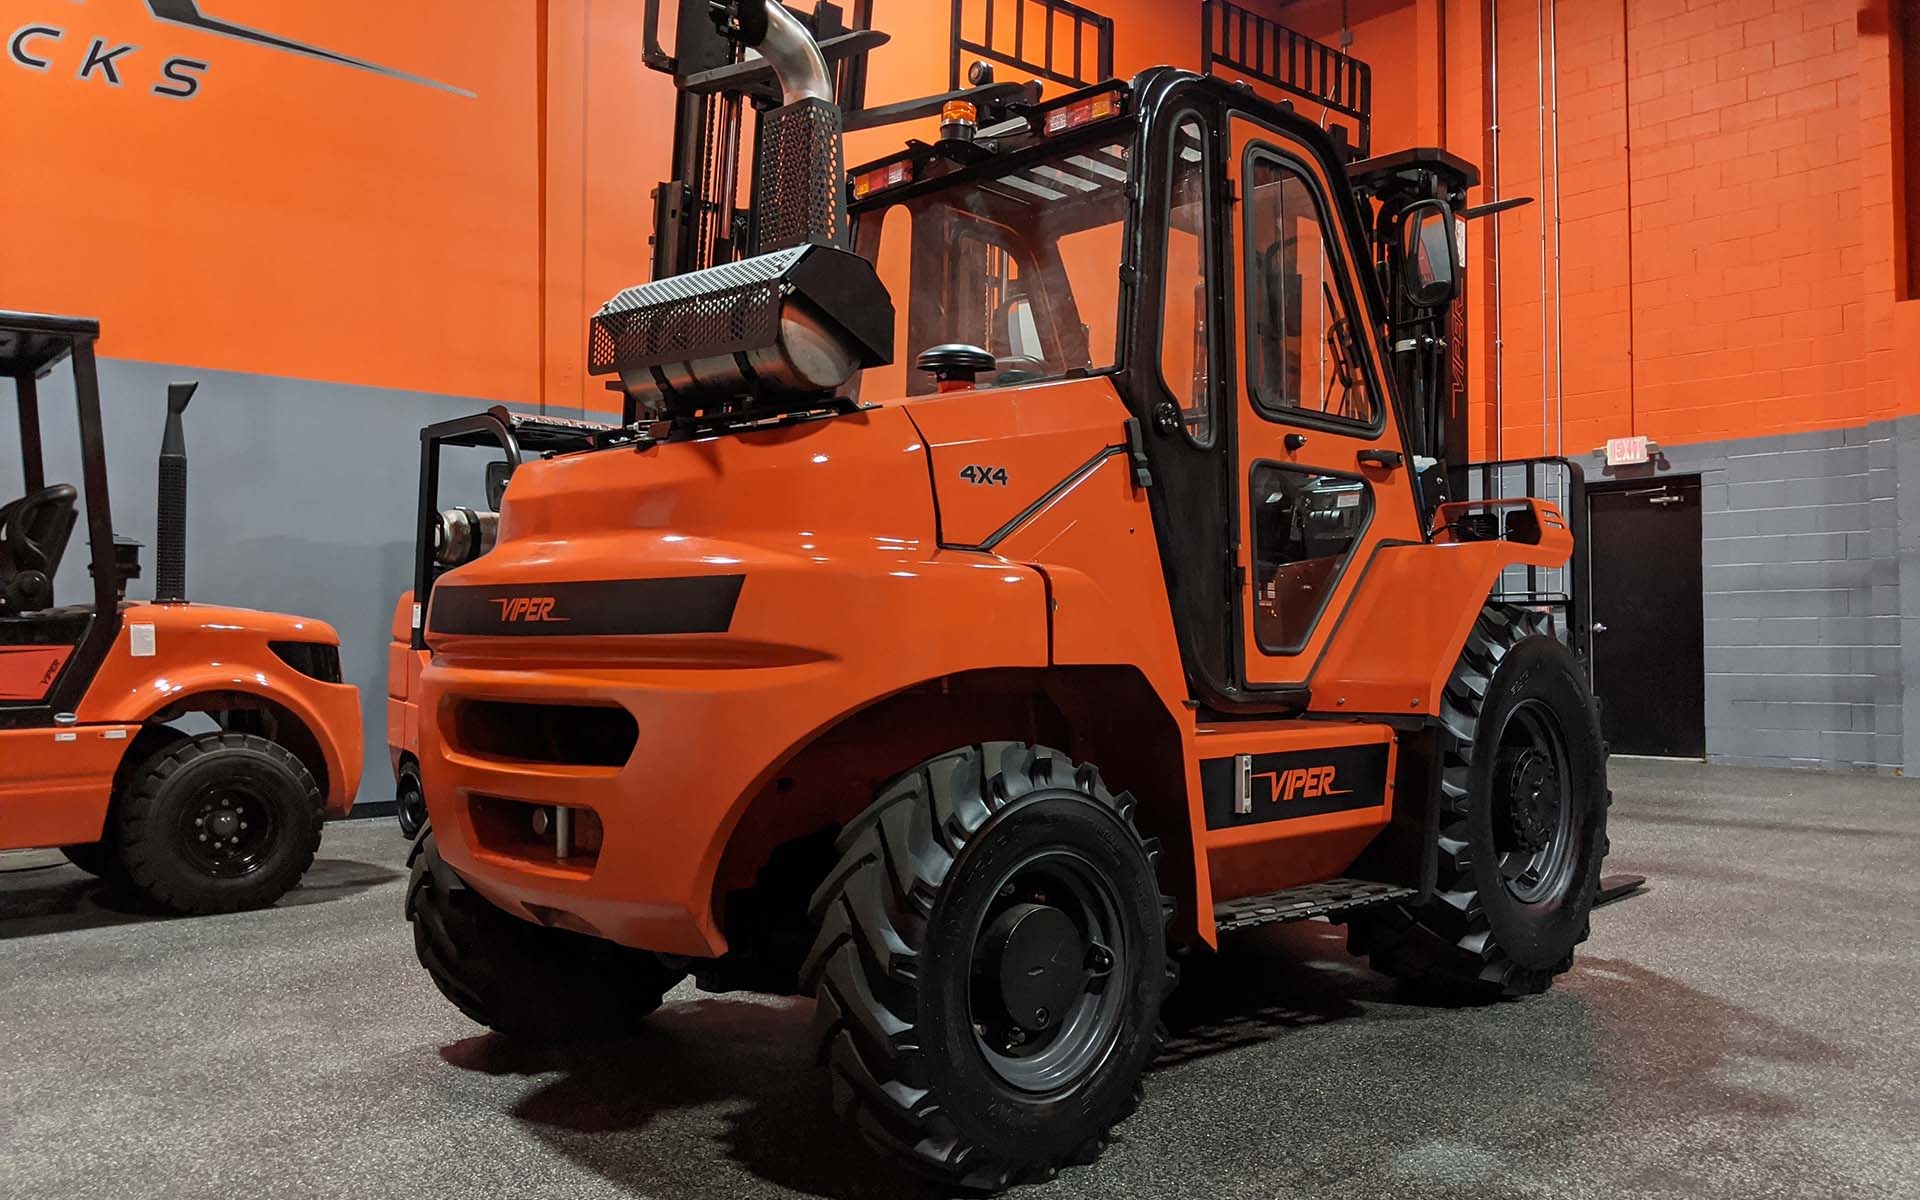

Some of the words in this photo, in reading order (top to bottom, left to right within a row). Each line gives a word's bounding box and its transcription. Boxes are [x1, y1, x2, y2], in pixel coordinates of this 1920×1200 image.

[1452, 278, 1465, 418] VIPER
[1613, 439, 1643, 461] EXIT
[960, 465, 1009, 487] 4X4
[488, 597, 571, 621] VIPER
[1251, 766, 1354, 802] VIPER
